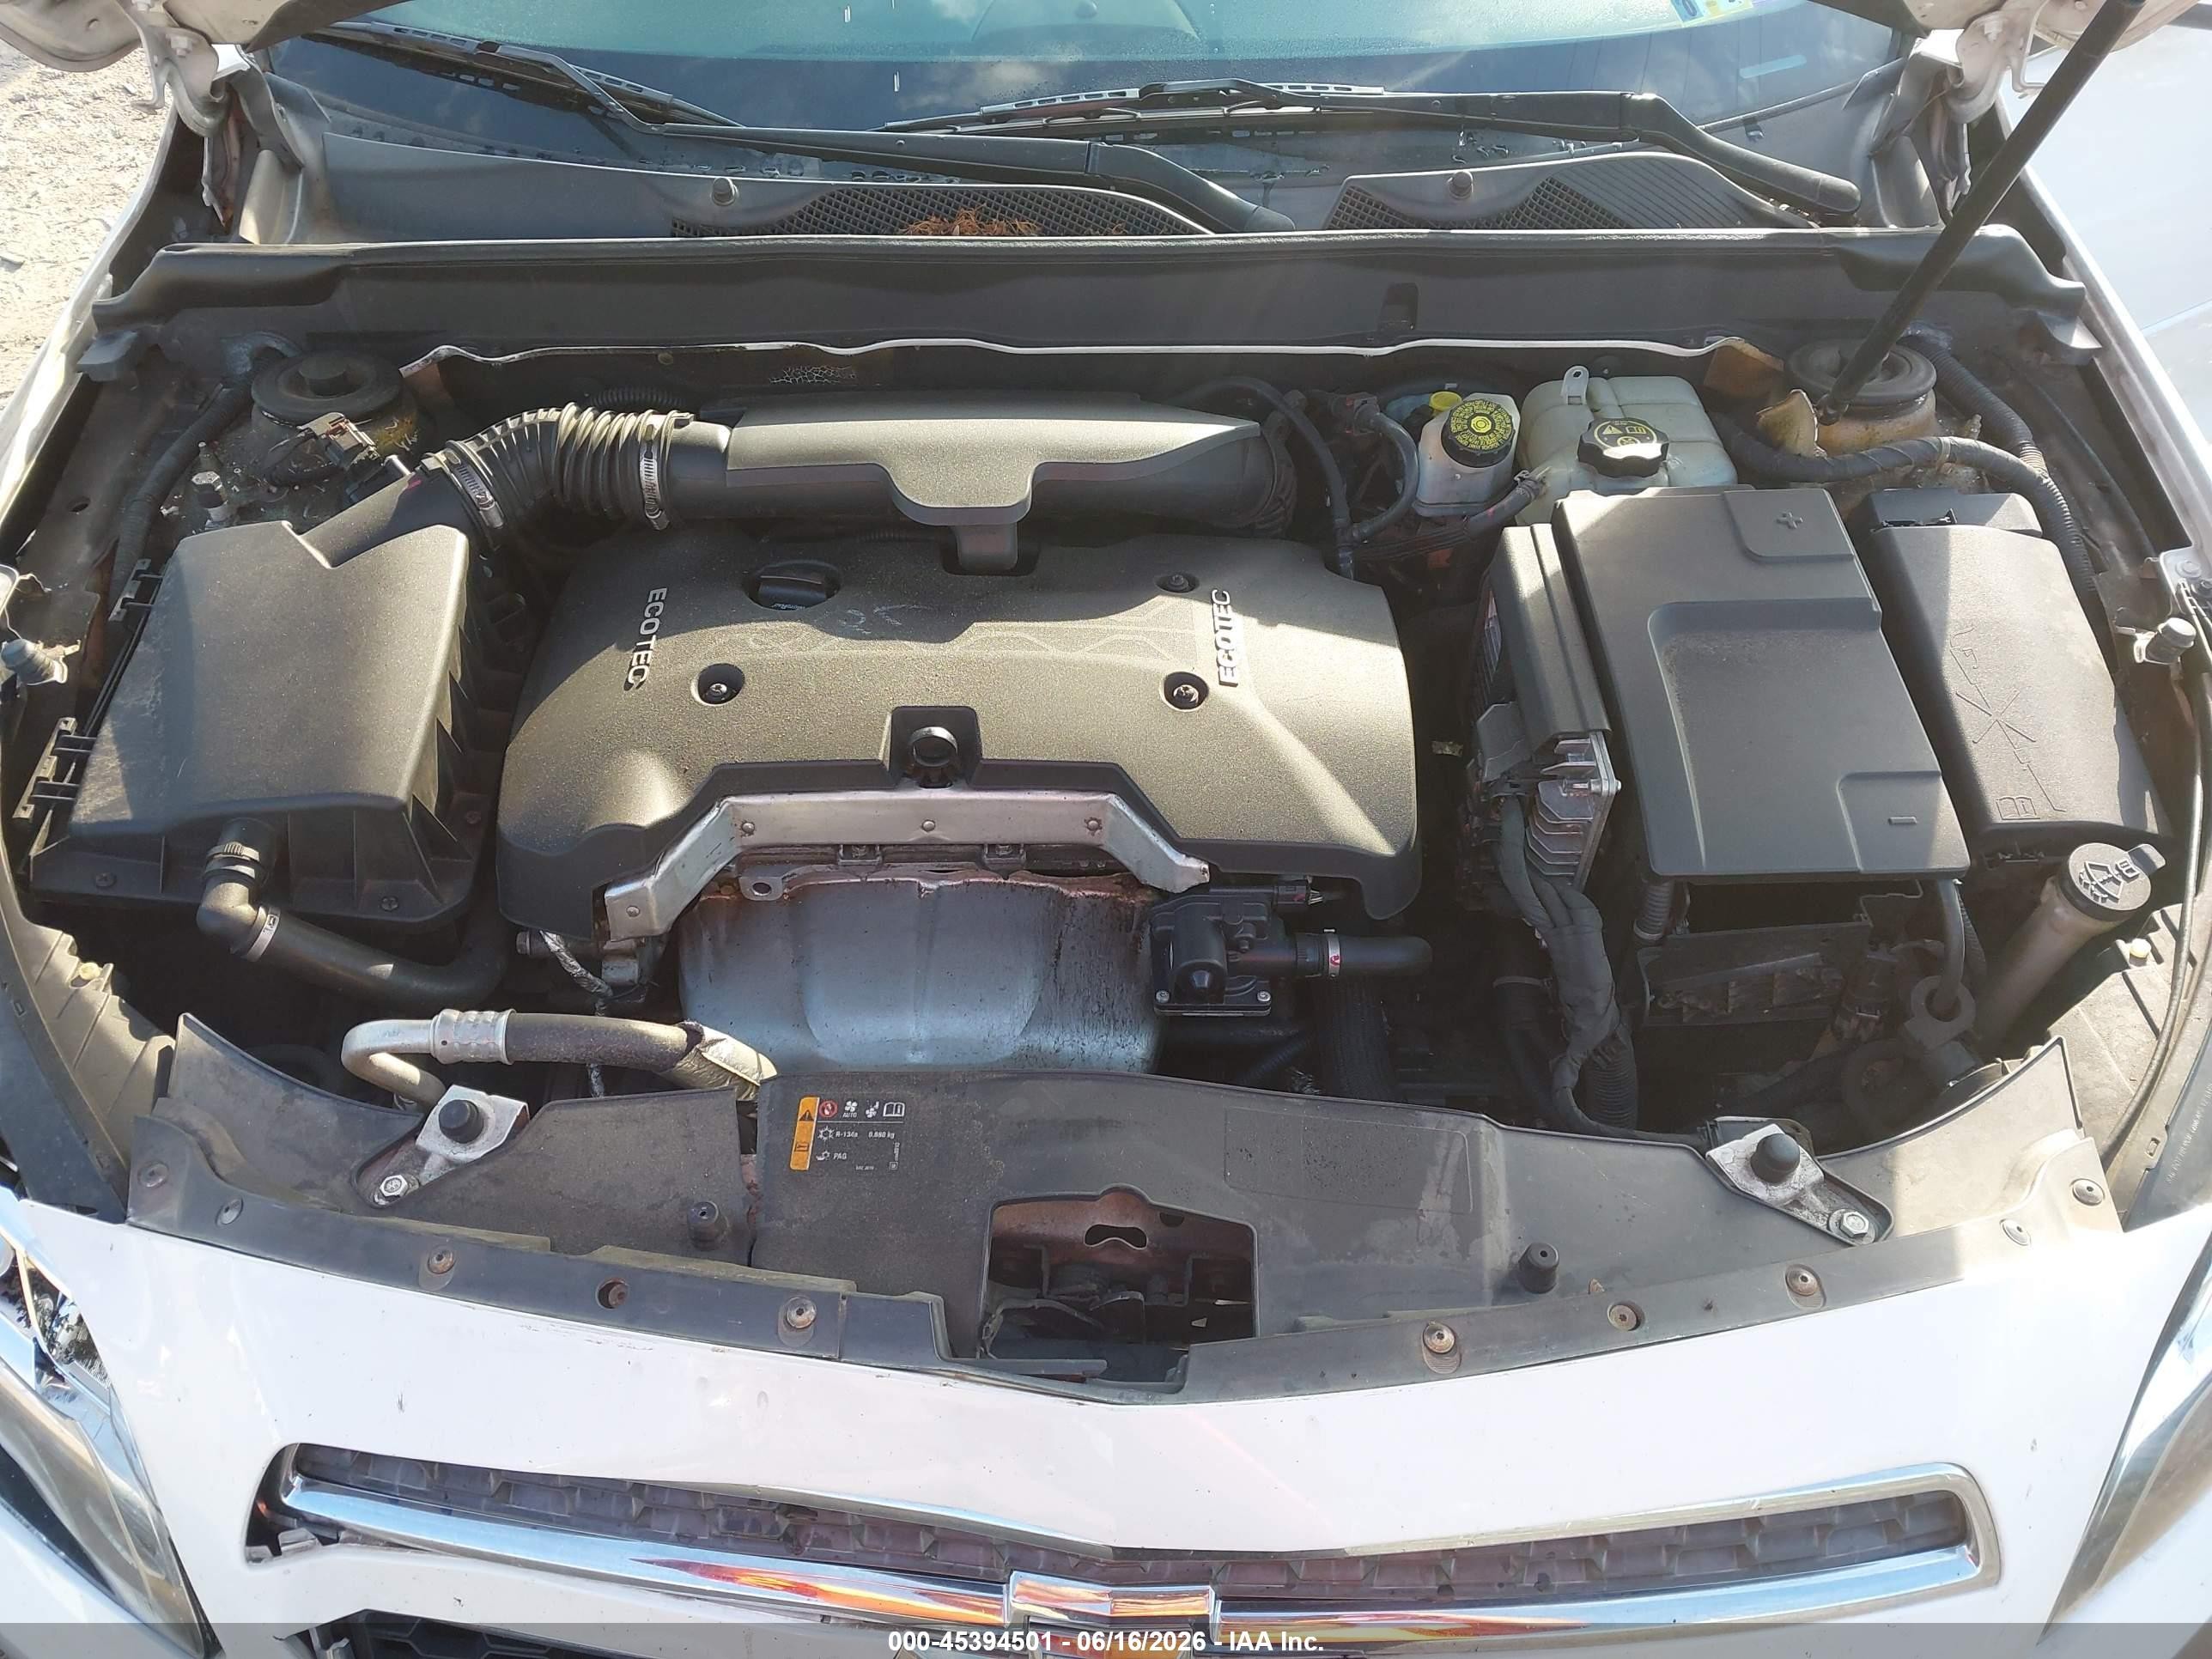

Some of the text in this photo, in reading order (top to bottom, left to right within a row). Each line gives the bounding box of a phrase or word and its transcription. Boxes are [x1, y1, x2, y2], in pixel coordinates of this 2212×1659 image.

[627, 586, 668, 685] ECOTEC
[1211, 589, 1238, 687] ECOTEC
[887, 1130, 896, 1139] kg
